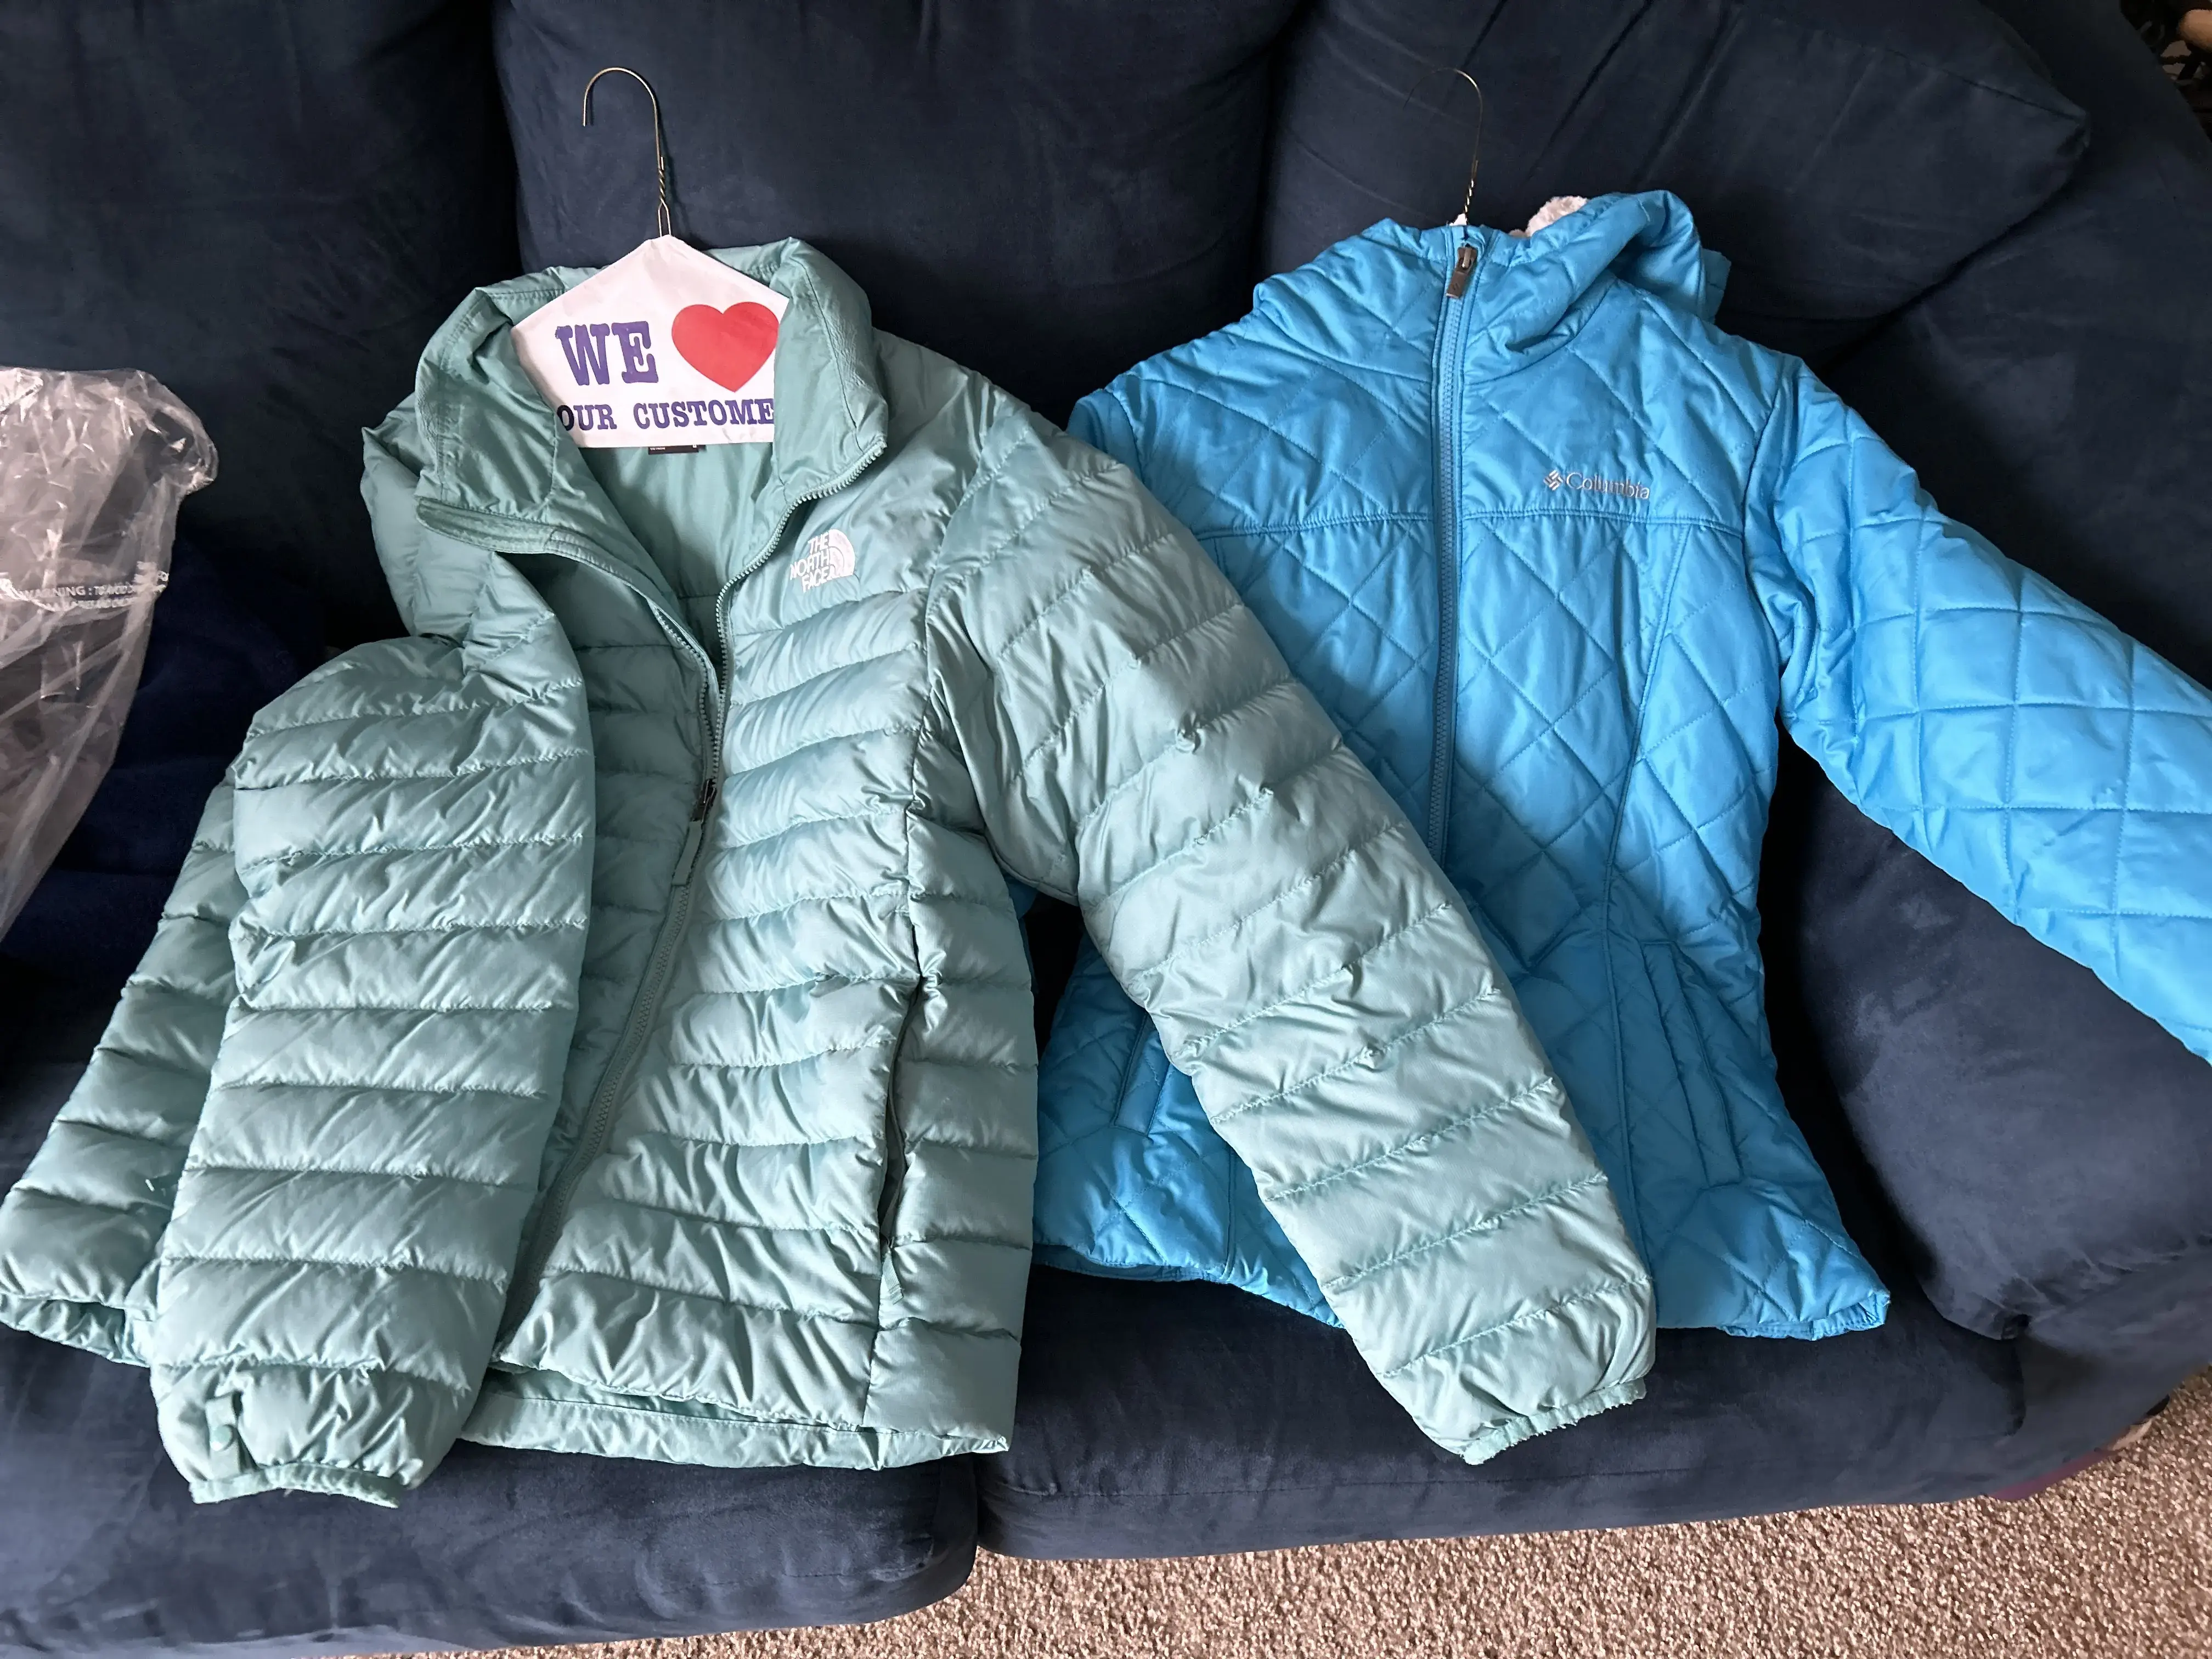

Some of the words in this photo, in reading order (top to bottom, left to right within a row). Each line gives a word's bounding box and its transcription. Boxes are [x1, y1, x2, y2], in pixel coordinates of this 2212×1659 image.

[555, 321, 658, 385] WE
[557, 404, 617, 431] OUR
[633, 398, 774, 429] CUSTOME
[1566, 472, 1650, 499] Columbia
[808, 532, 829, 554] THE
[790, 548, 830, 580] NORTH
[802, 566, 830, 593] FACE
